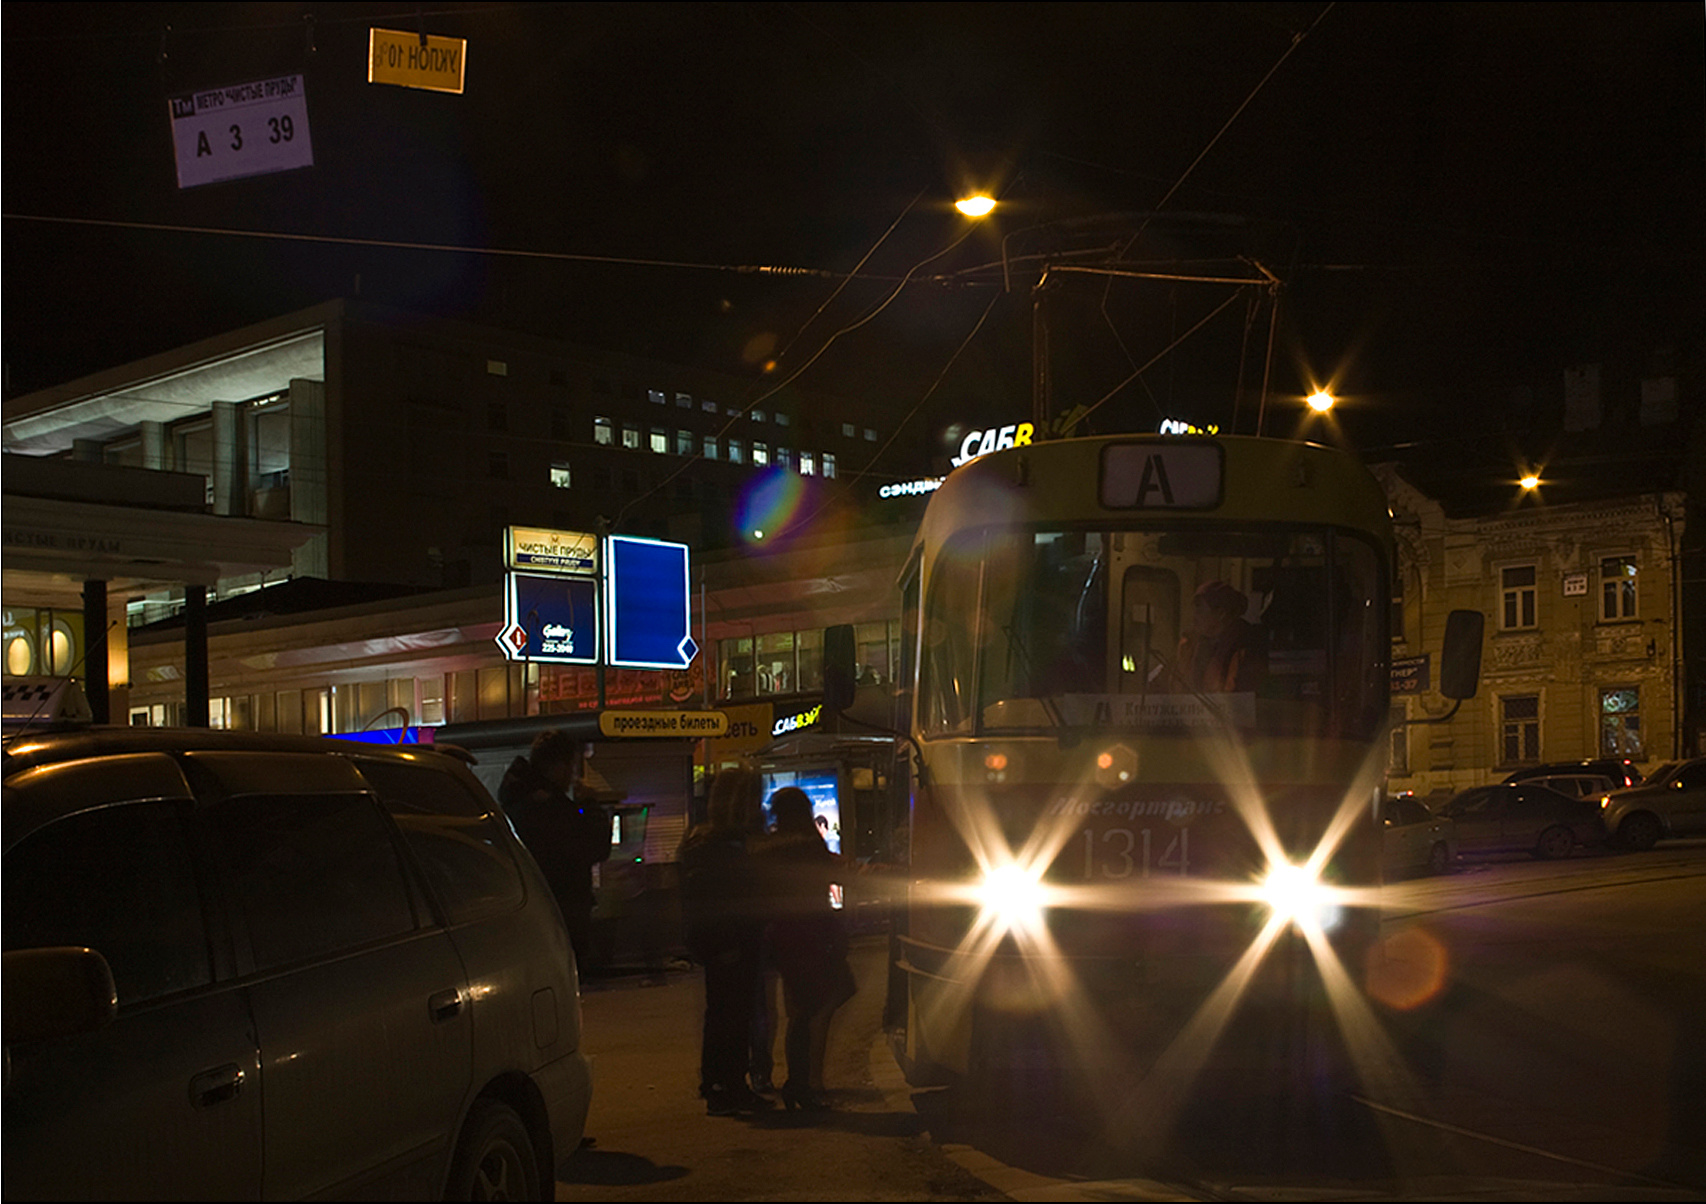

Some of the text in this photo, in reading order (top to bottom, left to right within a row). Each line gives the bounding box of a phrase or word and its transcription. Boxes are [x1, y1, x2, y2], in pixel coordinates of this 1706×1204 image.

[196, 91, 225, 110] МЕТРО
[197, 114, 294, 157] А 3 39
[1136, 454, 1174, 505] А
[518, 542, 558, 556] ЧИСТЫЕ
[613, 713, 720, 733] проездные билеты
[1083, 826, 1191, 879] 1314
